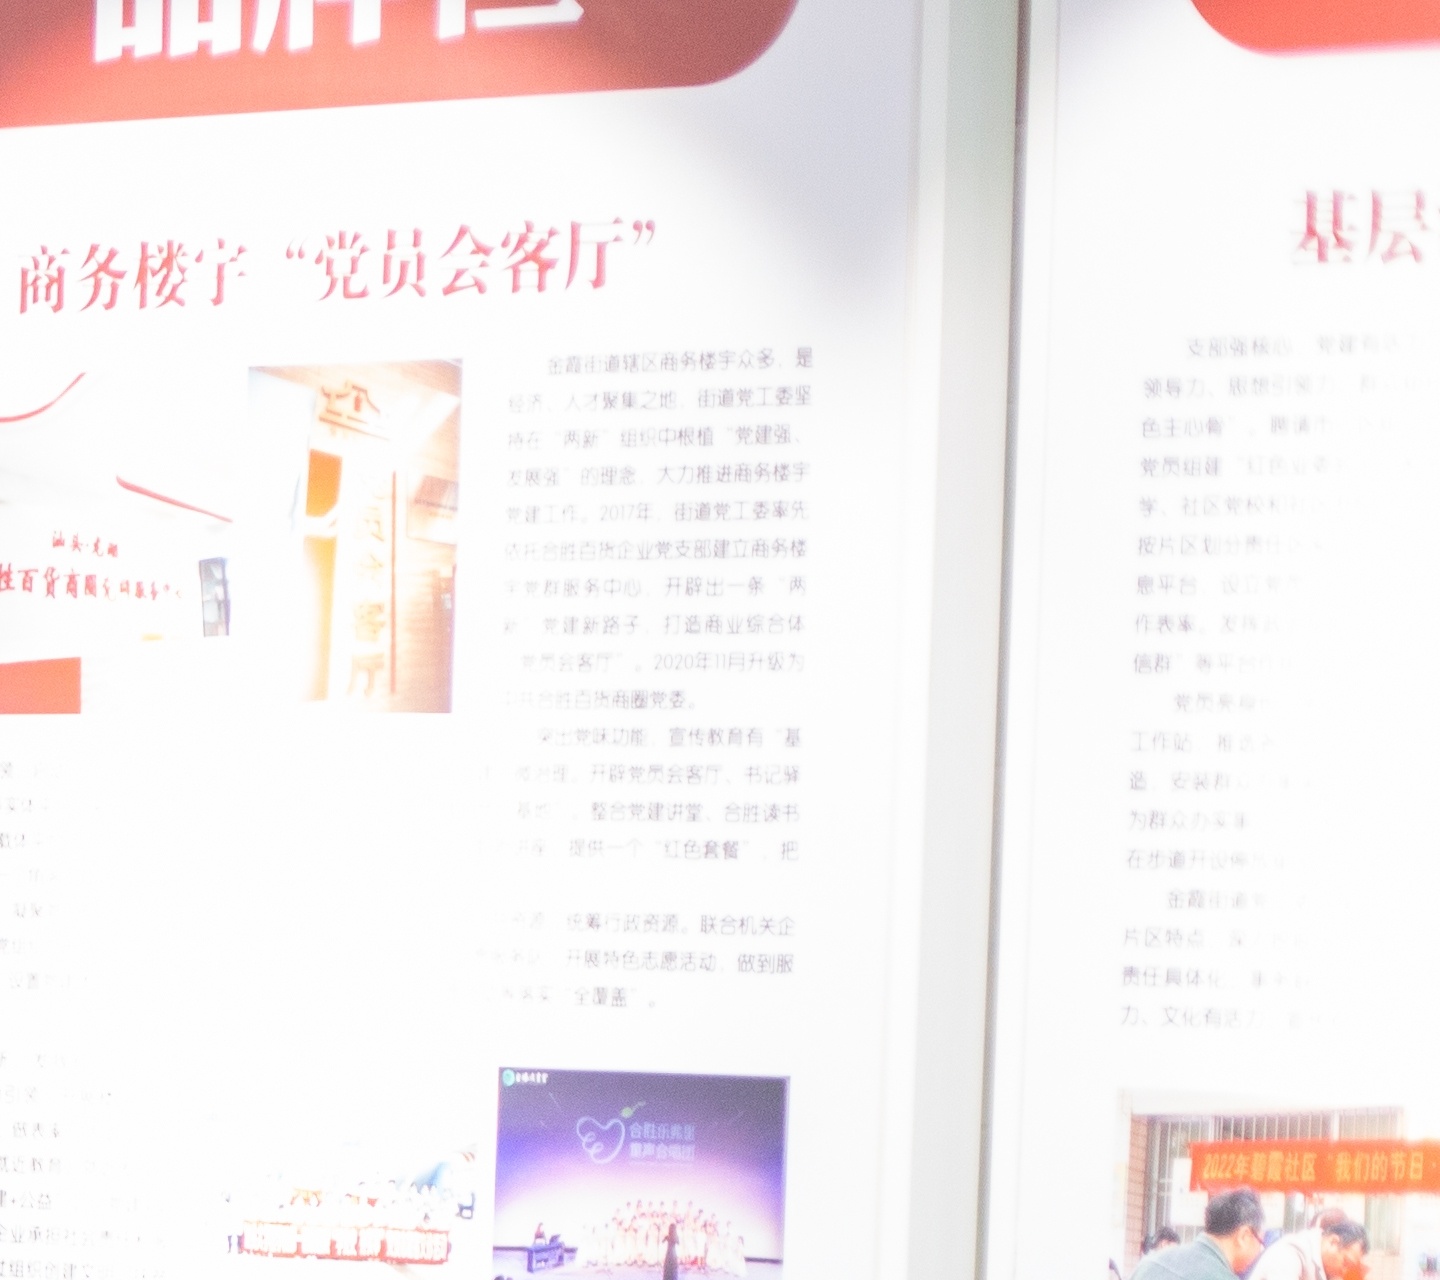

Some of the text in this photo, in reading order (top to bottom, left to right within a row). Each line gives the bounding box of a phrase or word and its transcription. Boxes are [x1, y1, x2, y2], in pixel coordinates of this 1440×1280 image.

[16, 216, 659, 318] 商务楼宇“党员会客厅”
[1290, 187, 1428, 266] 基层
